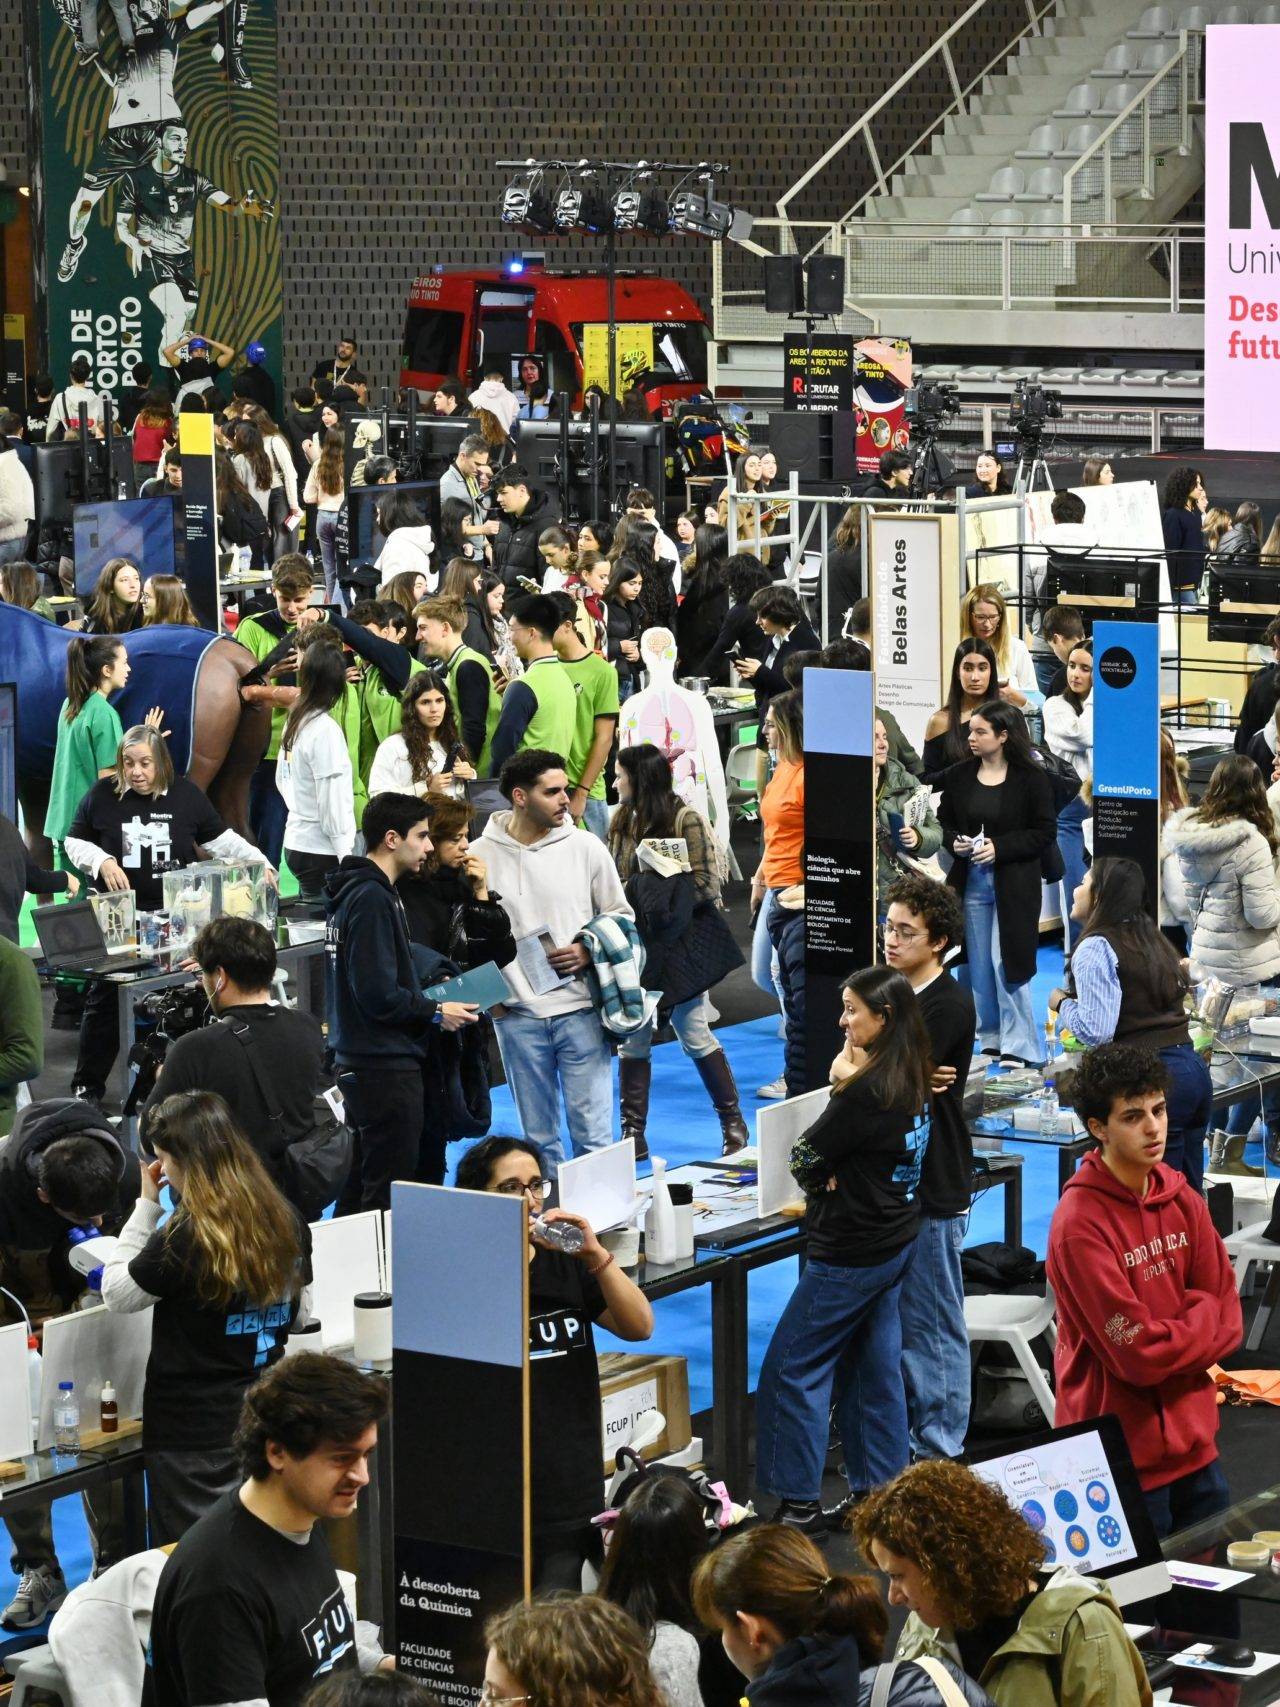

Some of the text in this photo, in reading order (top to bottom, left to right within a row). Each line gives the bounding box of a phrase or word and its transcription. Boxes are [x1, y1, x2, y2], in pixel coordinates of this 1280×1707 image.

[421, 290, 440, 301] TINTO
[71, 309, 92, 342] DE
[120, 296, 143, 387] PORTO
[838, 349, 848, 357] DA
[790, 358, 815, 366] AREOA
[892, 538, 907, 665] Belas Artes
[878, 561, 889, 665] Faculdade de
[1098, 784, 1152, 796] GreenUPorto
[1098, 808, 1129, 817] Investigação
[1098, 815, 1122, 824] Produção
[1098, 823, 1133, 832] Agroalimentar
[807, 854, 837, 864] Biologia,
[807, 865, 861, 876] ciência que abre
[807, 875, 840, 883] caminhos
[807, 915, 844, 923] DEPARTAMENTO
[529, 1317, 581, 1343] UP
[606, 1417, 628, 1435] FCUP
[400, 1571, 481, 1600] À descoberta
[400, 1594, 473, 1618] da Química
[400, 1642, 452, 1660] FACULDADE
[400, 1656, 455, 1675] DE CIÊNCIAS
[411, 1676, 470, 1695] ARTAMENTO
